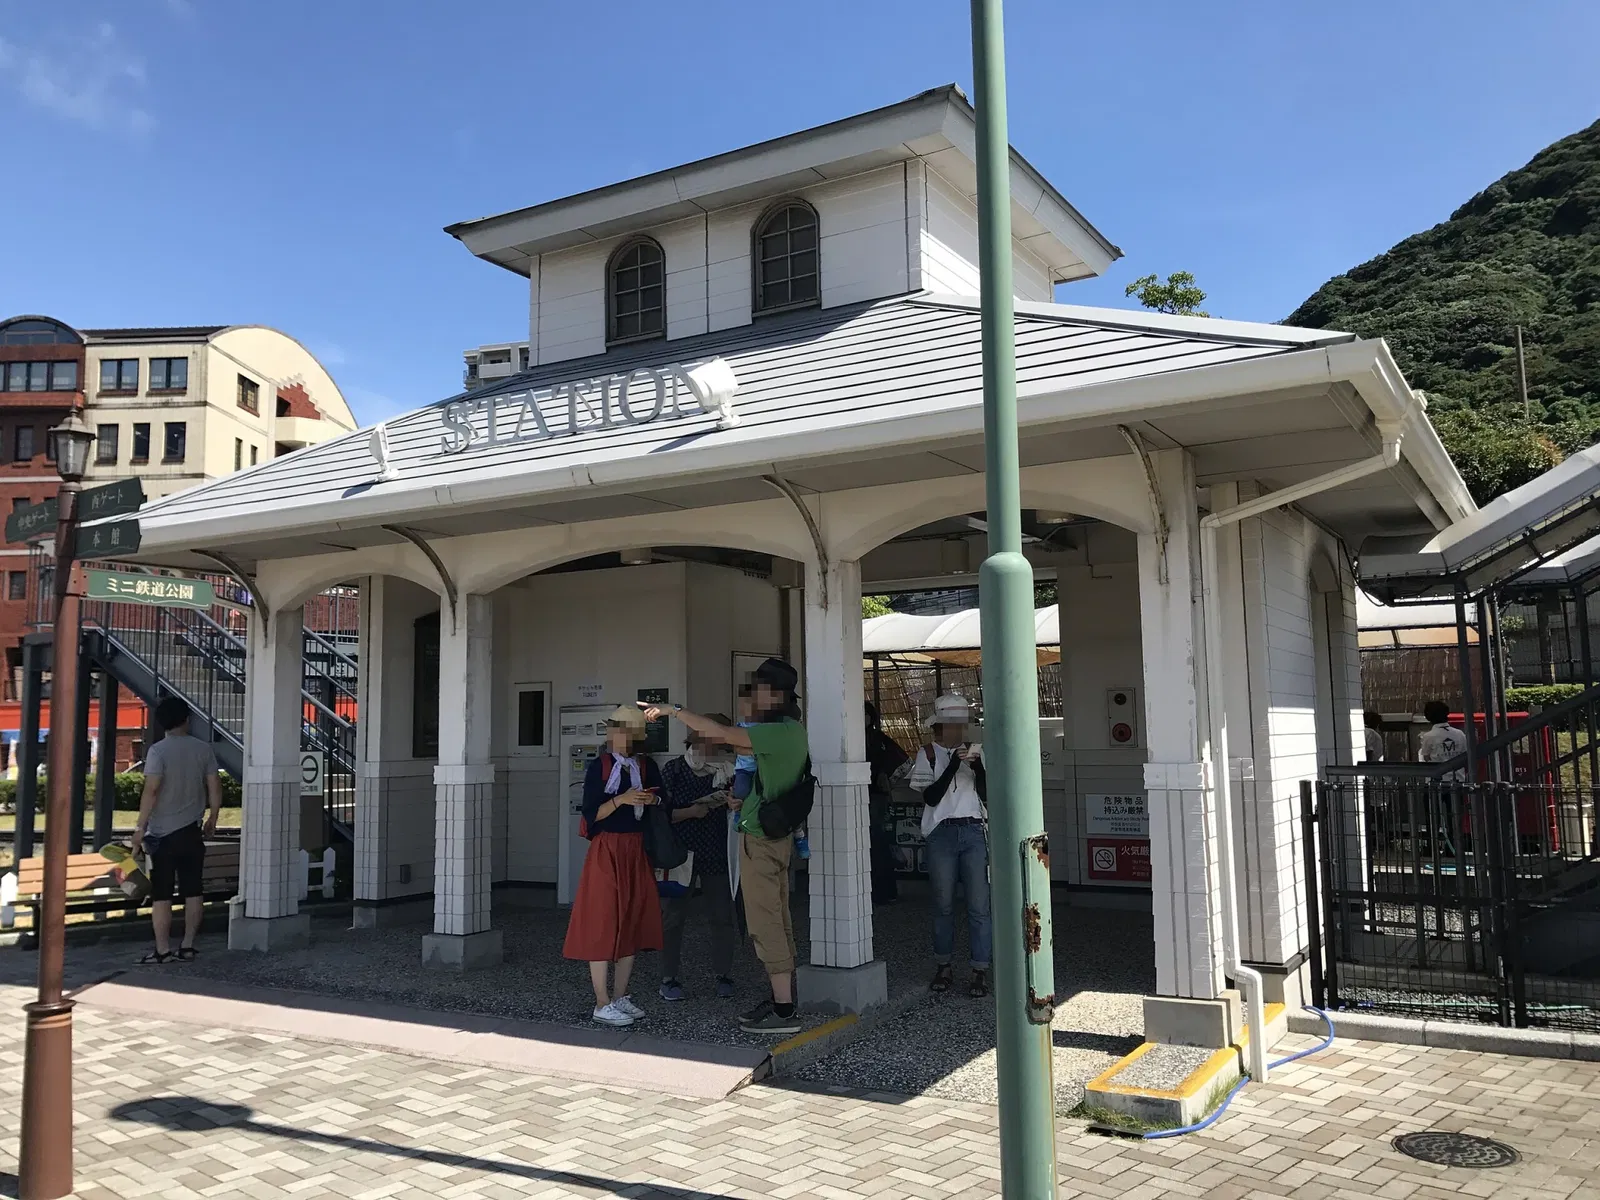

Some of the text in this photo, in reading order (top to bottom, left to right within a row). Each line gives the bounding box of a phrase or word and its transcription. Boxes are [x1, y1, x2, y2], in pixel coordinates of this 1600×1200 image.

[441, 362, 708, 454] STATION
[17, 507, 50, 531] 中央ゲート
[91, 527, 121, 547] 本館
[106, 577, 194, 599] ミニ鉄道公園
[1103, 796, 1144, 805] 危険物品
[1103, 805, 1144, 815] 持込み厳禁
